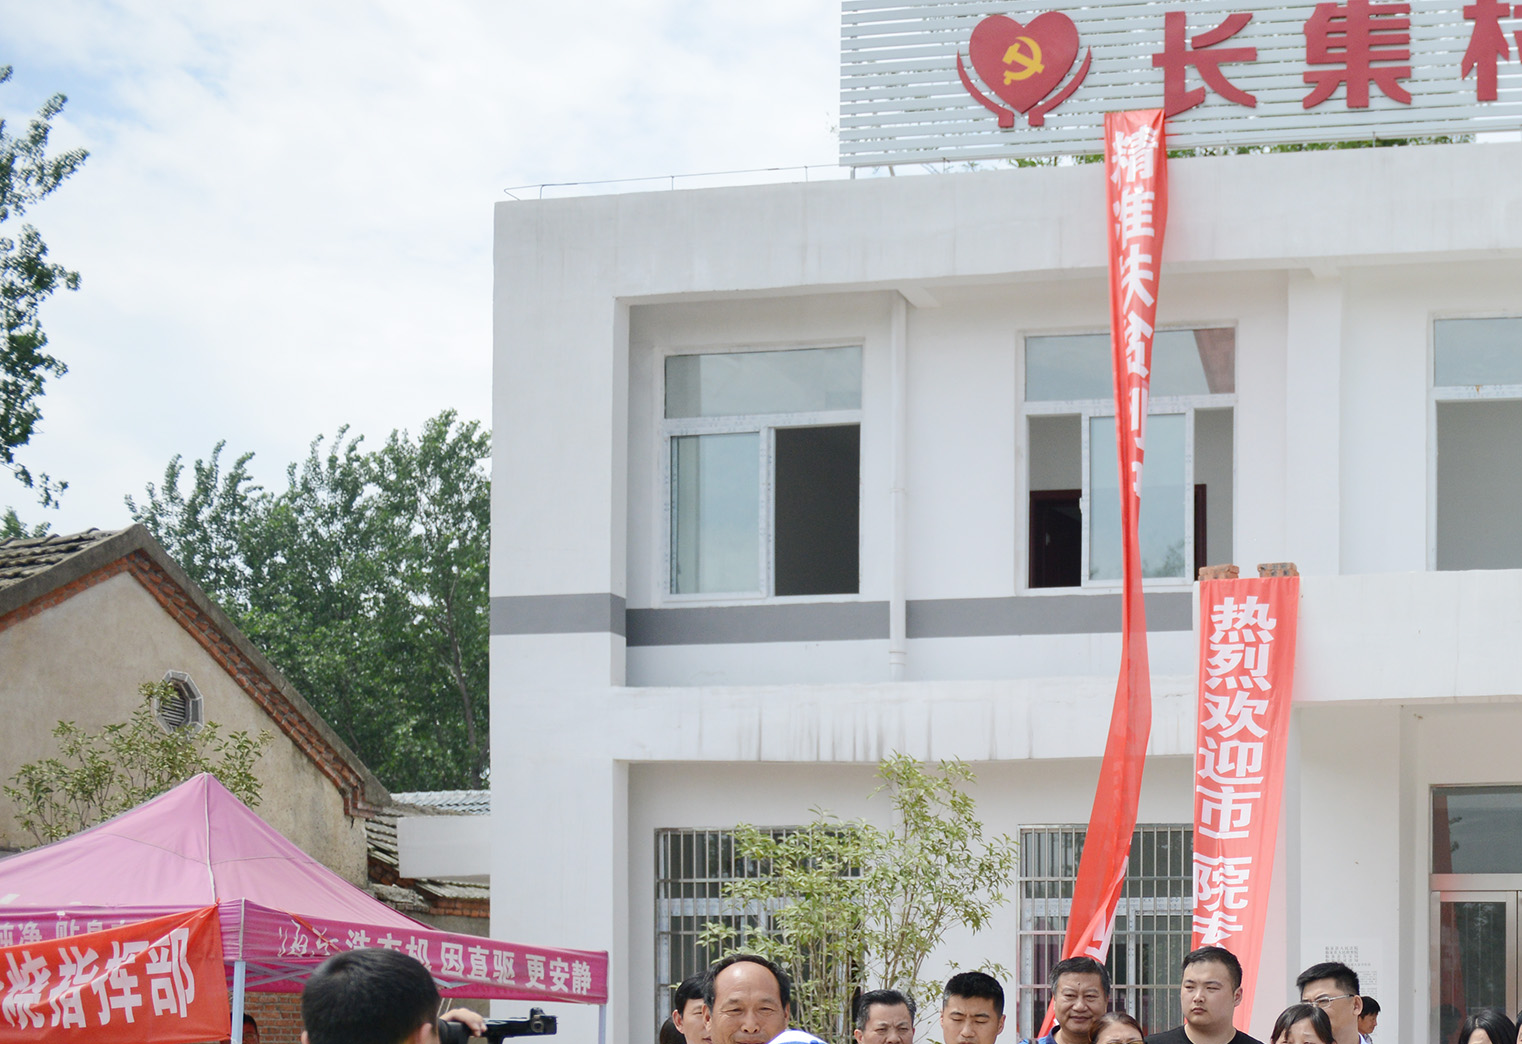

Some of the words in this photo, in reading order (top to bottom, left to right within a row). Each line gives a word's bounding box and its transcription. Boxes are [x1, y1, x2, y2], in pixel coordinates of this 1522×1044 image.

[0, 927, 195, 1030] 烧指挥部
[440, 941, 516, 987] 因直驱
[525, 953, 592, 996] 更安静
